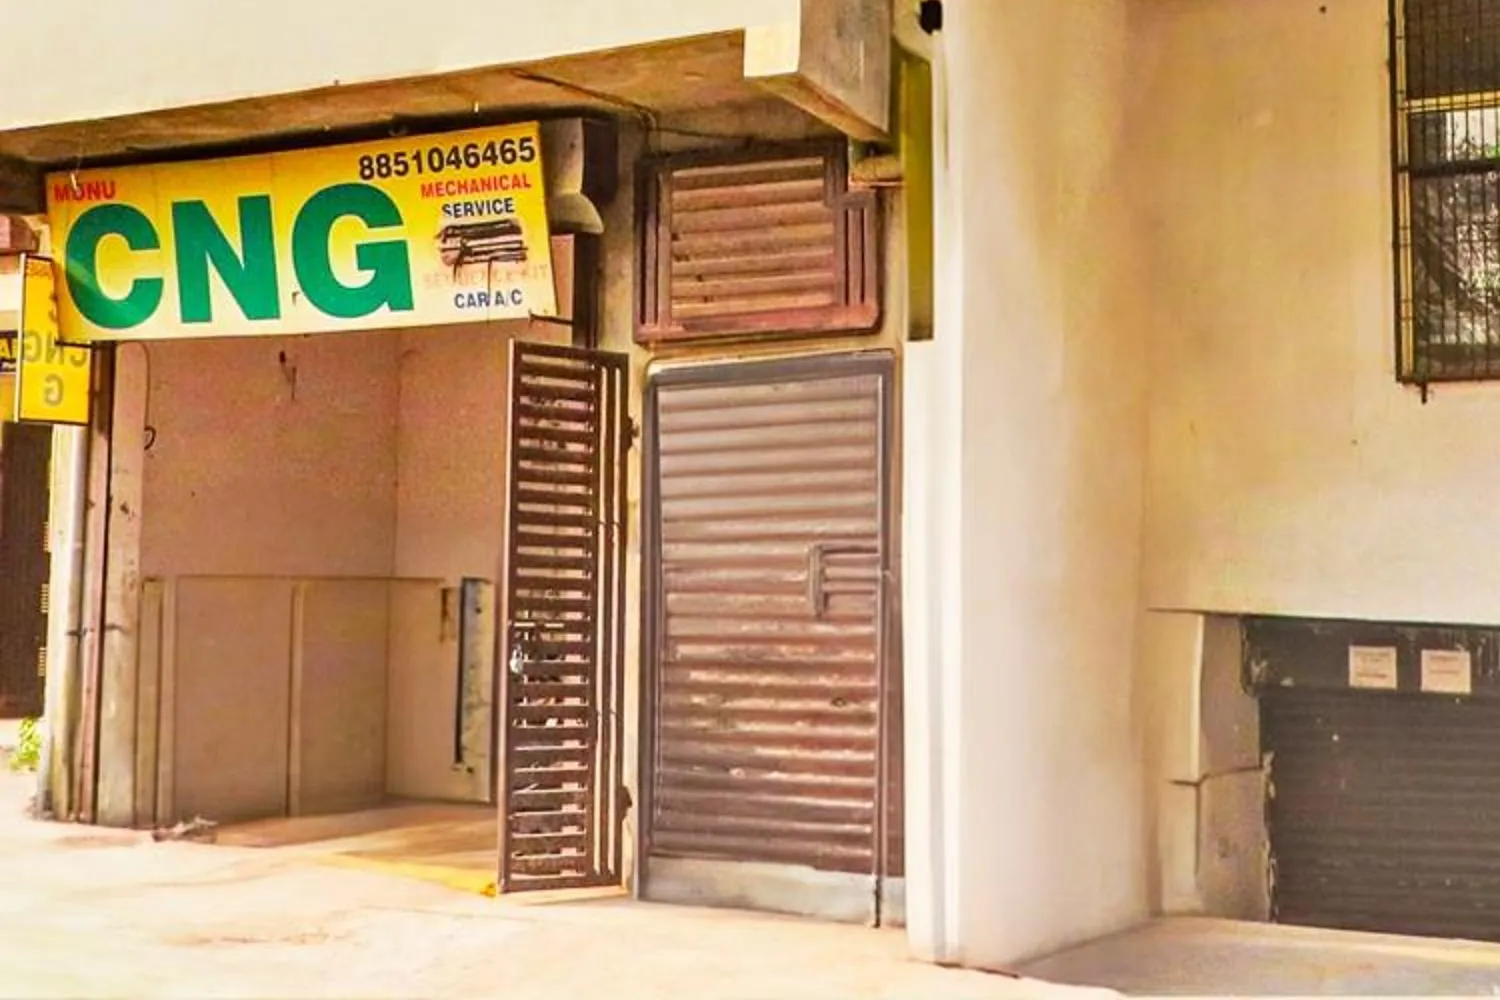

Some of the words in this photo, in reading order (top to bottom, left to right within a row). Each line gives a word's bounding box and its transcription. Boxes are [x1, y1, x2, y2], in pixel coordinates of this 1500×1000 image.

[359, 136, 536, 181] 8851046465
[420, 173, 532, 199] MECHANICAL
[441, 197, 515, 219] SERVICE
[64, 182, 416, 330] CNG
[453, 291, 490, 310] CAR
